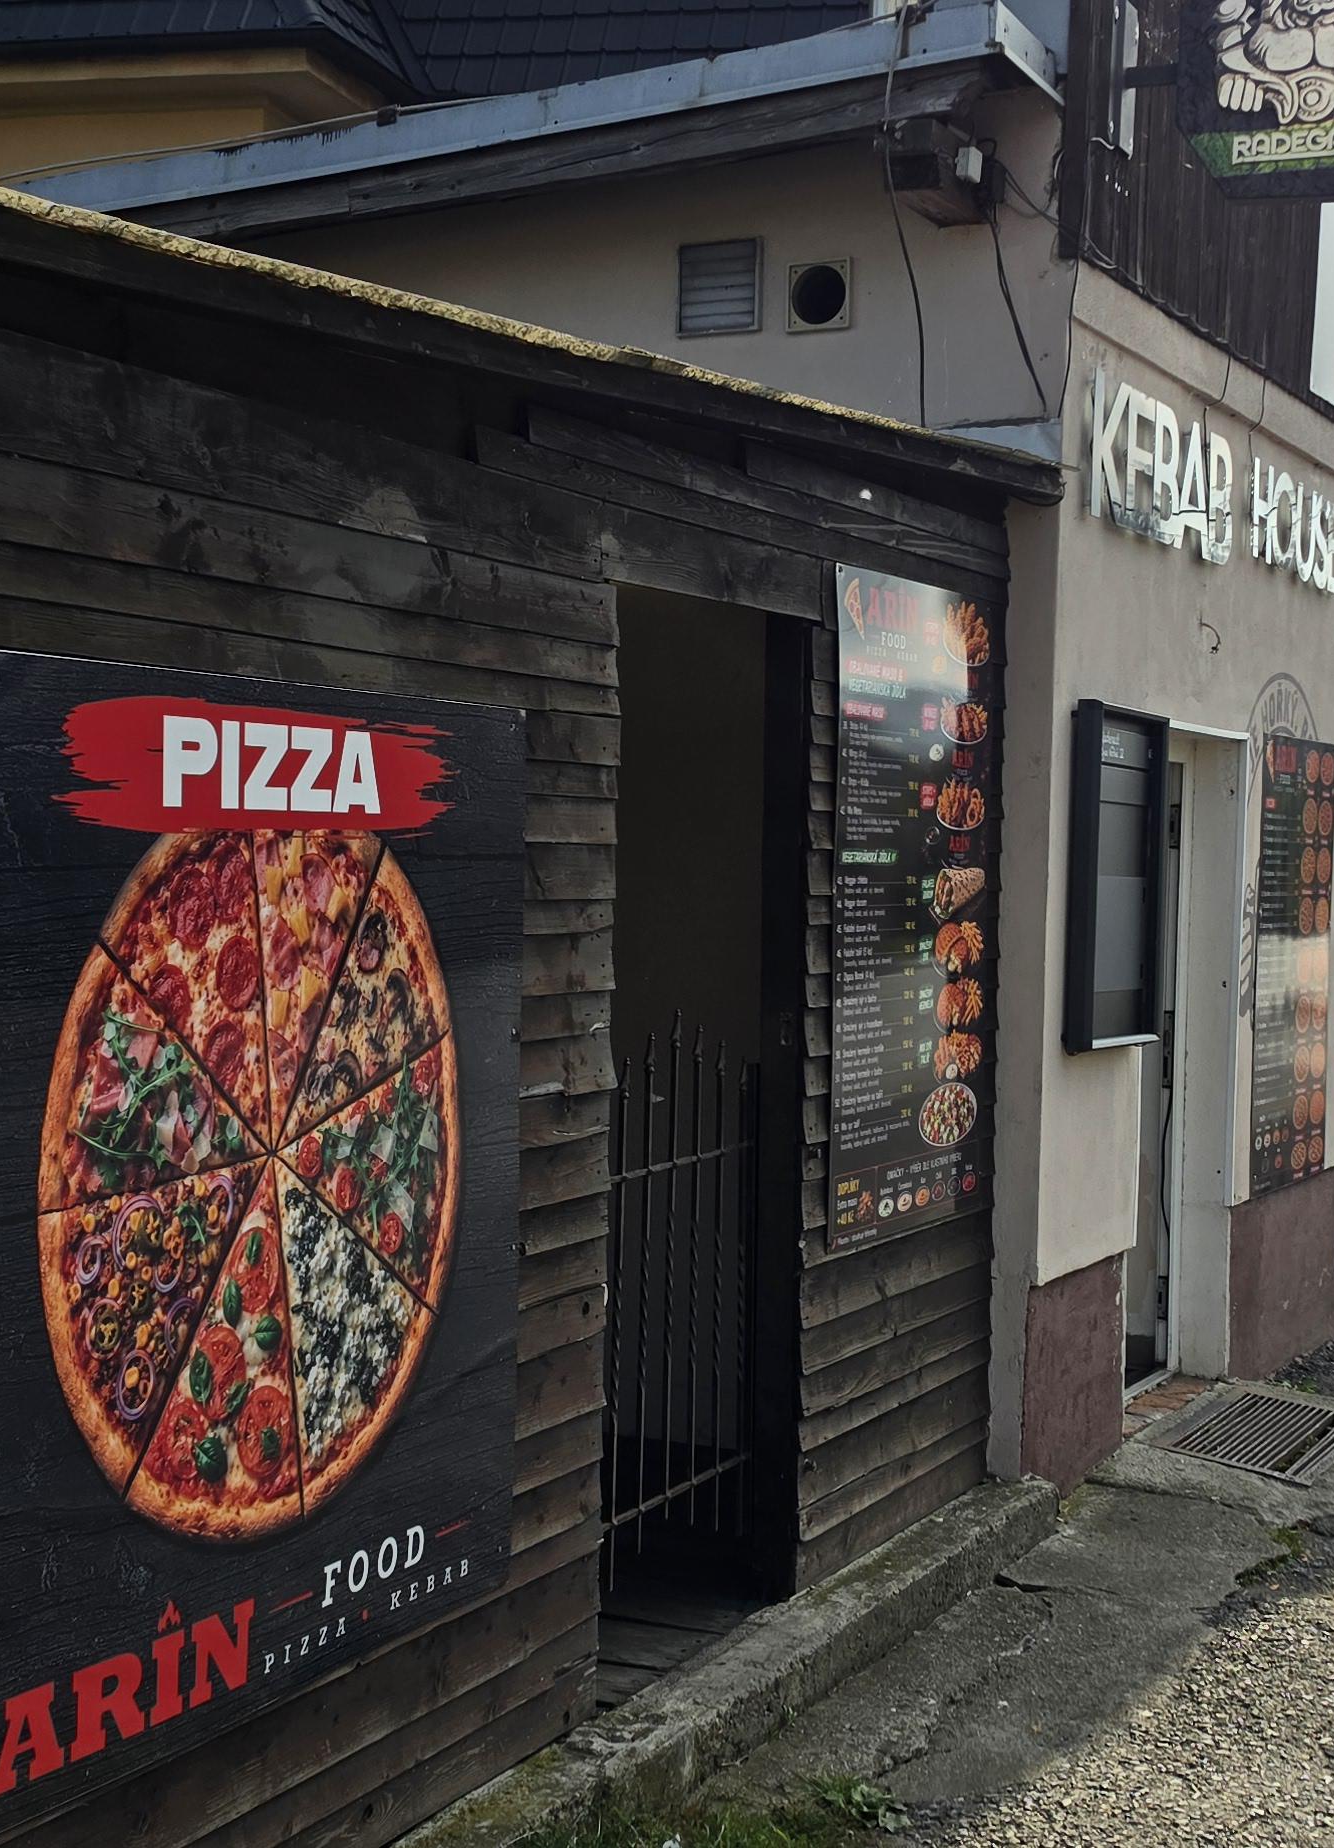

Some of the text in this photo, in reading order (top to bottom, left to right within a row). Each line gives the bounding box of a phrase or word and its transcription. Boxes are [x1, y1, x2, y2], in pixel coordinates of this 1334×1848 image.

[1090, 366, 1234, 566] KEBAB
[881, 631, 906, 649] FOOD
[162, 714, 381, 815] PIZZA
[263, 1558, 471, 1675] PIZZA KEBAB
[321, 1524, 426, 1609] FOOD
